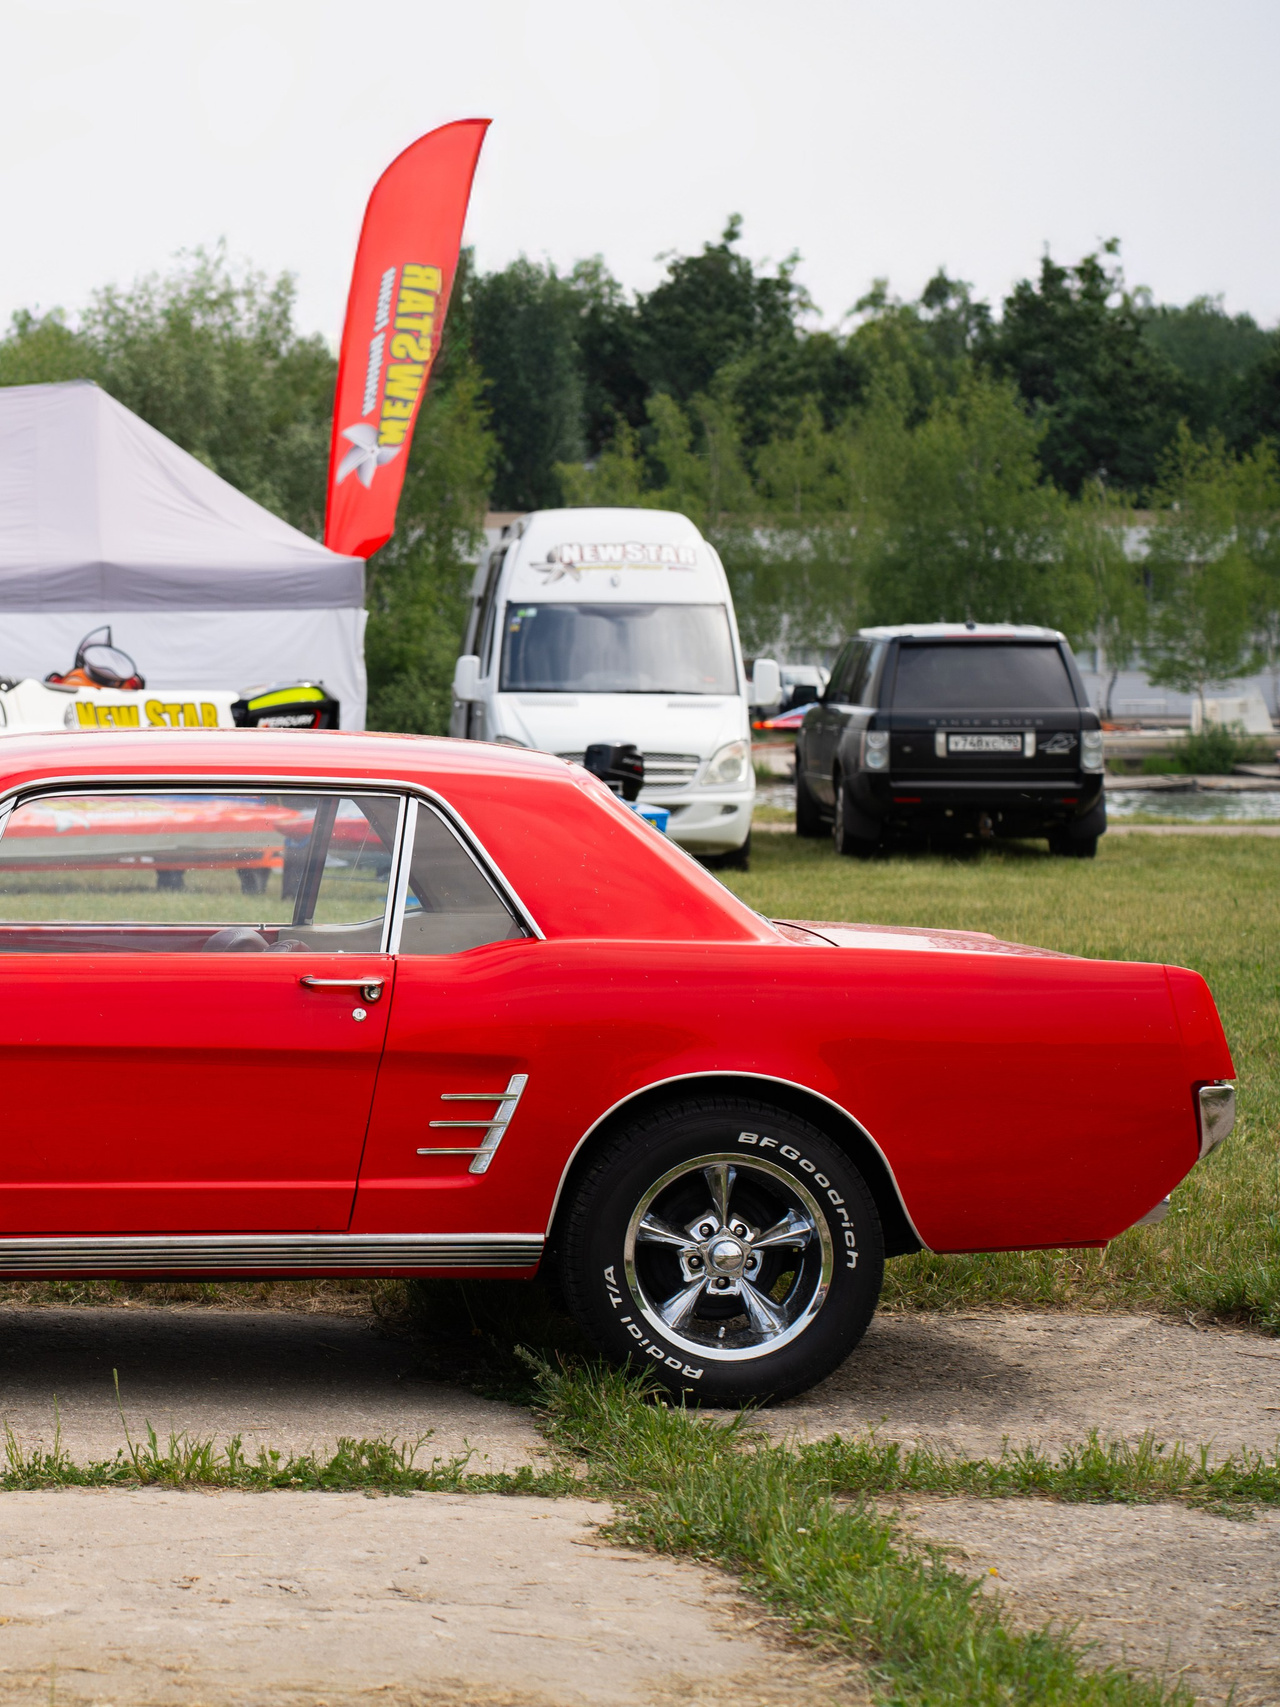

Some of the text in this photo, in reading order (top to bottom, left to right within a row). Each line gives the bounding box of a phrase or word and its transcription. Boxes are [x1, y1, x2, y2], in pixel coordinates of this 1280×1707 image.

[559, 541, 698, 565] NEWSTAR
[75, 699, 219, 728] NEW STAR
[257, 714, 315, 728] MERCURY
[928, 718, 1044, 726] RANGE ROVER
[737, 1131, 860, 1270] BFGoodrich
[603, 1265, 705, 1380] Radial T/A
